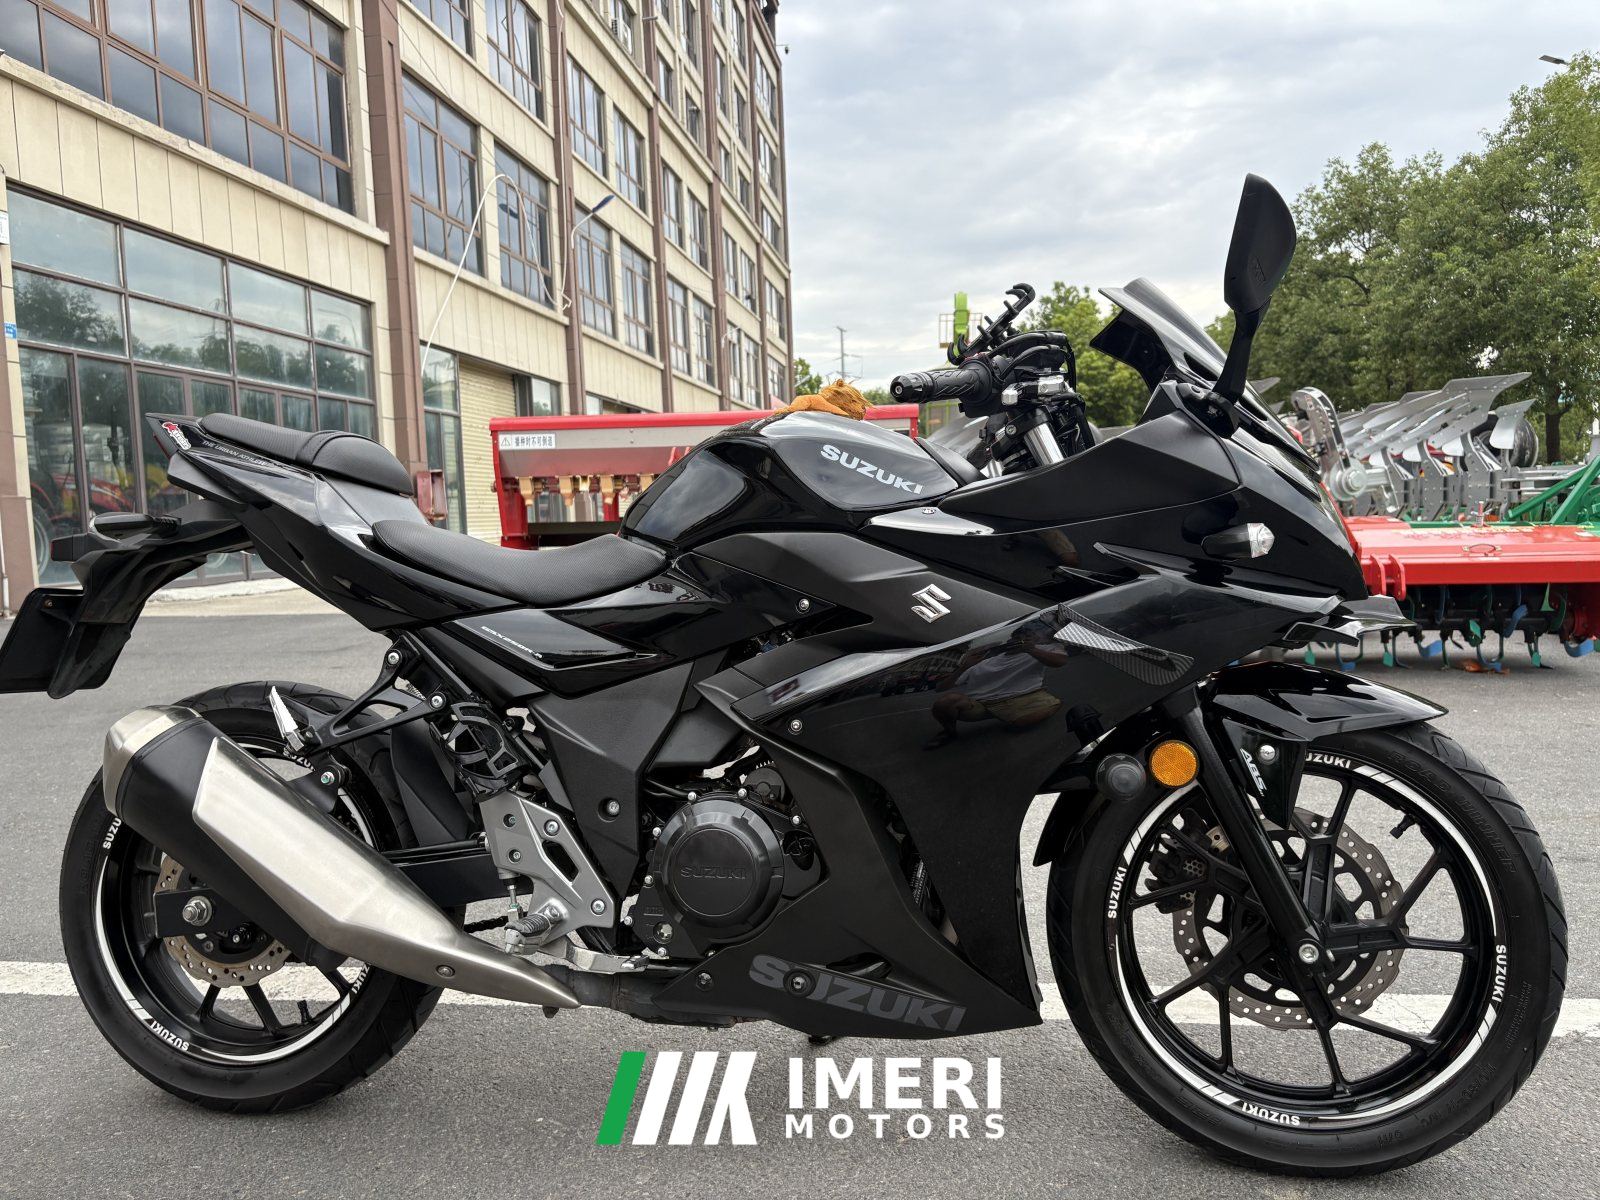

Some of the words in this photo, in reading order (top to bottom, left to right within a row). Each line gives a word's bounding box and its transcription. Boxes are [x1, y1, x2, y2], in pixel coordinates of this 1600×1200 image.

[820, 444, 923, 495] SUZUKI
[1240, 748, 1267, 792] ABS
[1304, 752, 1351, 769] UZUKI
[102, 817, 122, 850] SUZU
[680, 866, 746, 880] SUZUKI
[1107, 866, 1128, 919] SUZUKI
[1491, 944, 1507, 1003] SUZUKI
[150, 1020, 190, 1051] SUZUKI
[1241, 1102, 1300, 1126] SUZUKI
